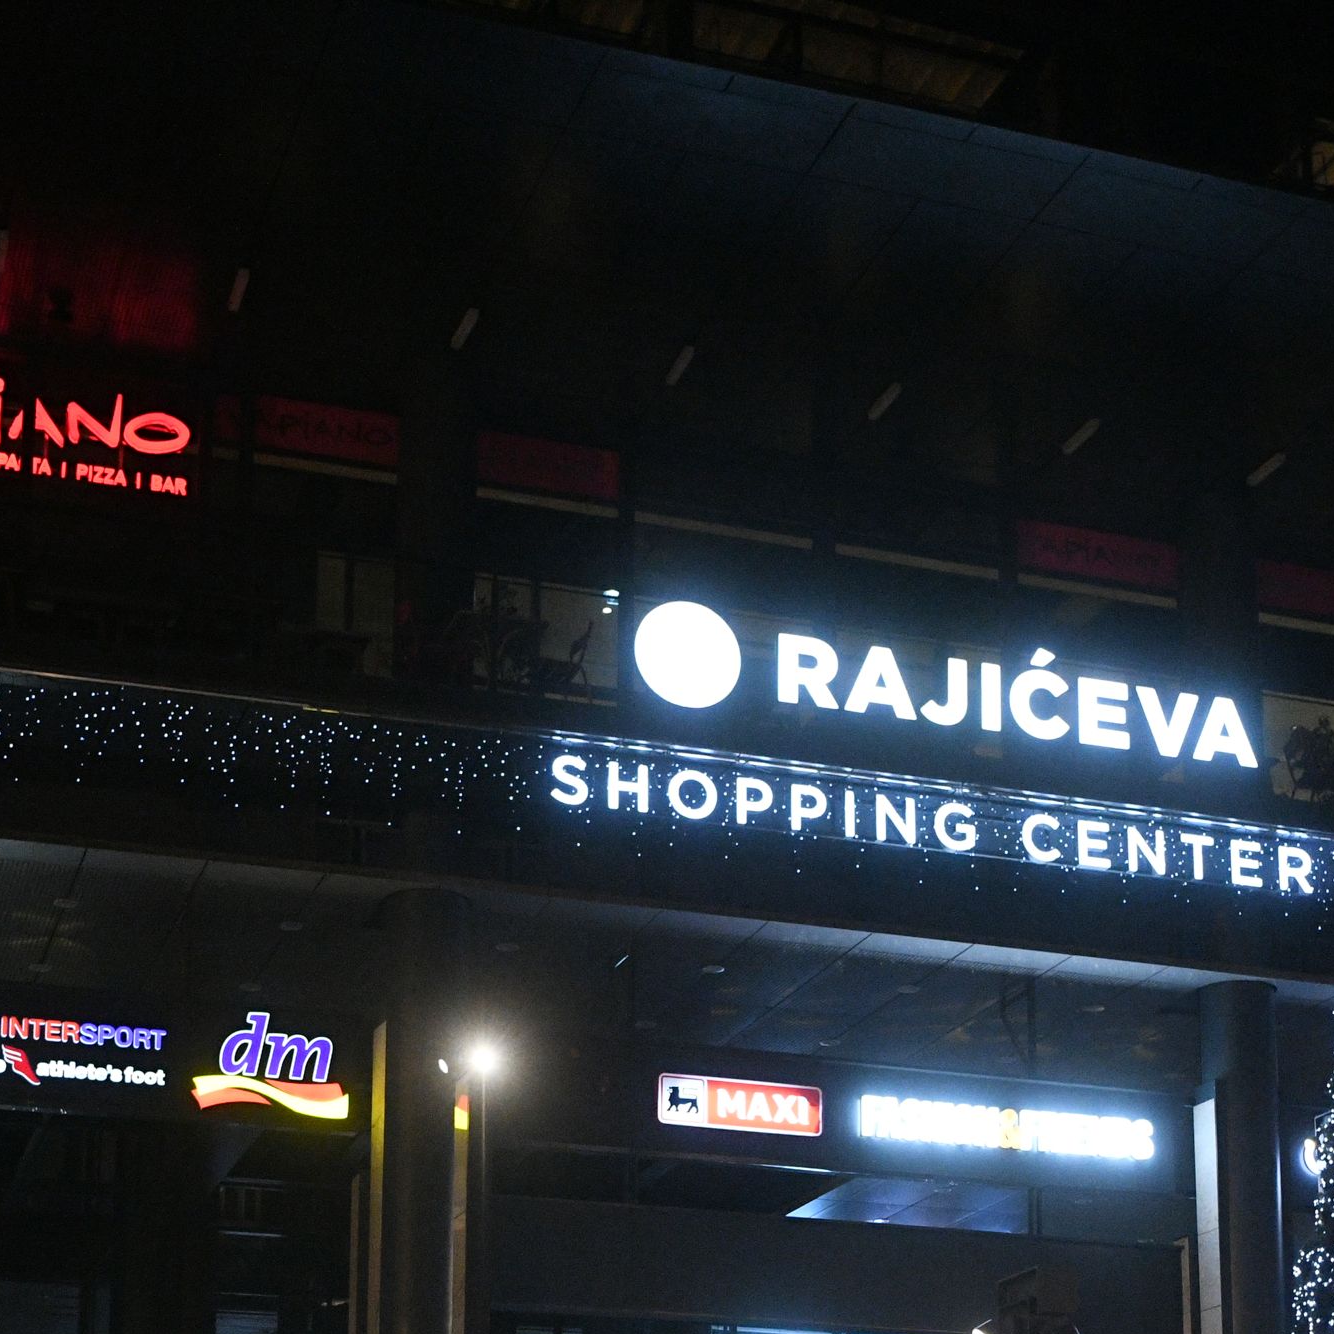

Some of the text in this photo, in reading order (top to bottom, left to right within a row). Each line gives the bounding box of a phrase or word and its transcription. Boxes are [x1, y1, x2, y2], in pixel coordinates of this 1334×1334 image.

[76, 463, 127, 487] PIZZA
[150, 474, 187, 496] BAR
[776, 632, 1258, 768] RAJIĆEVA
[549, 754, 1314, 895] SHOPPING CENTER
[0, 1016, 167, 1051] INTERSPORT
[219, 1011, 334, 1083] dm
[123, 1065, 166, 1087] foot
[715, 1086, 809, 1126] MAXI
